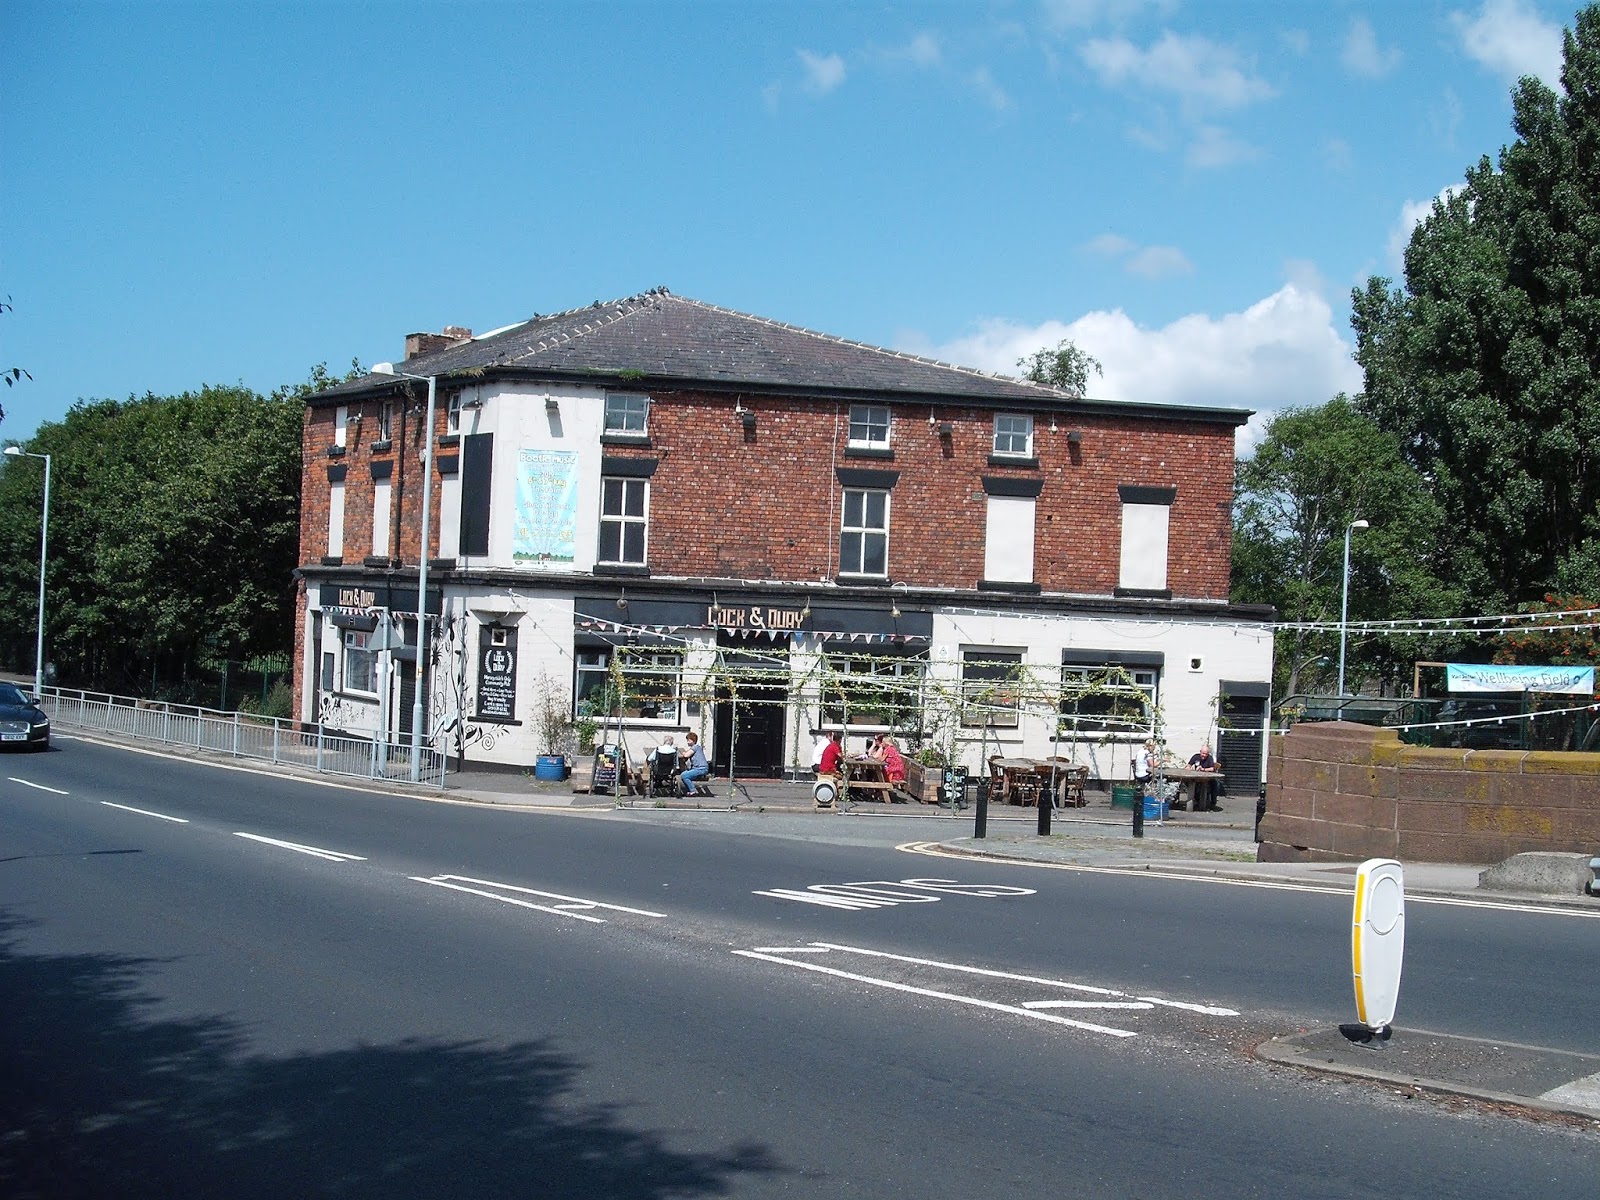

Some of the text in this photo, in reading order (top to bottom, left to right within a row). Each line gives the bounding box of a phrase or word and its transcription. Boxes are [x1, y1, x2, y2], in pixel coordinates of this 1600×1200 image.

[339, 588, 375, 608] LOCK & QUAY
[707, 606, 804, 629] LOCK & QUAY
[1476, 671, 1538, 687] Wellbeing
[1541, 673, 1570, 686] Field
